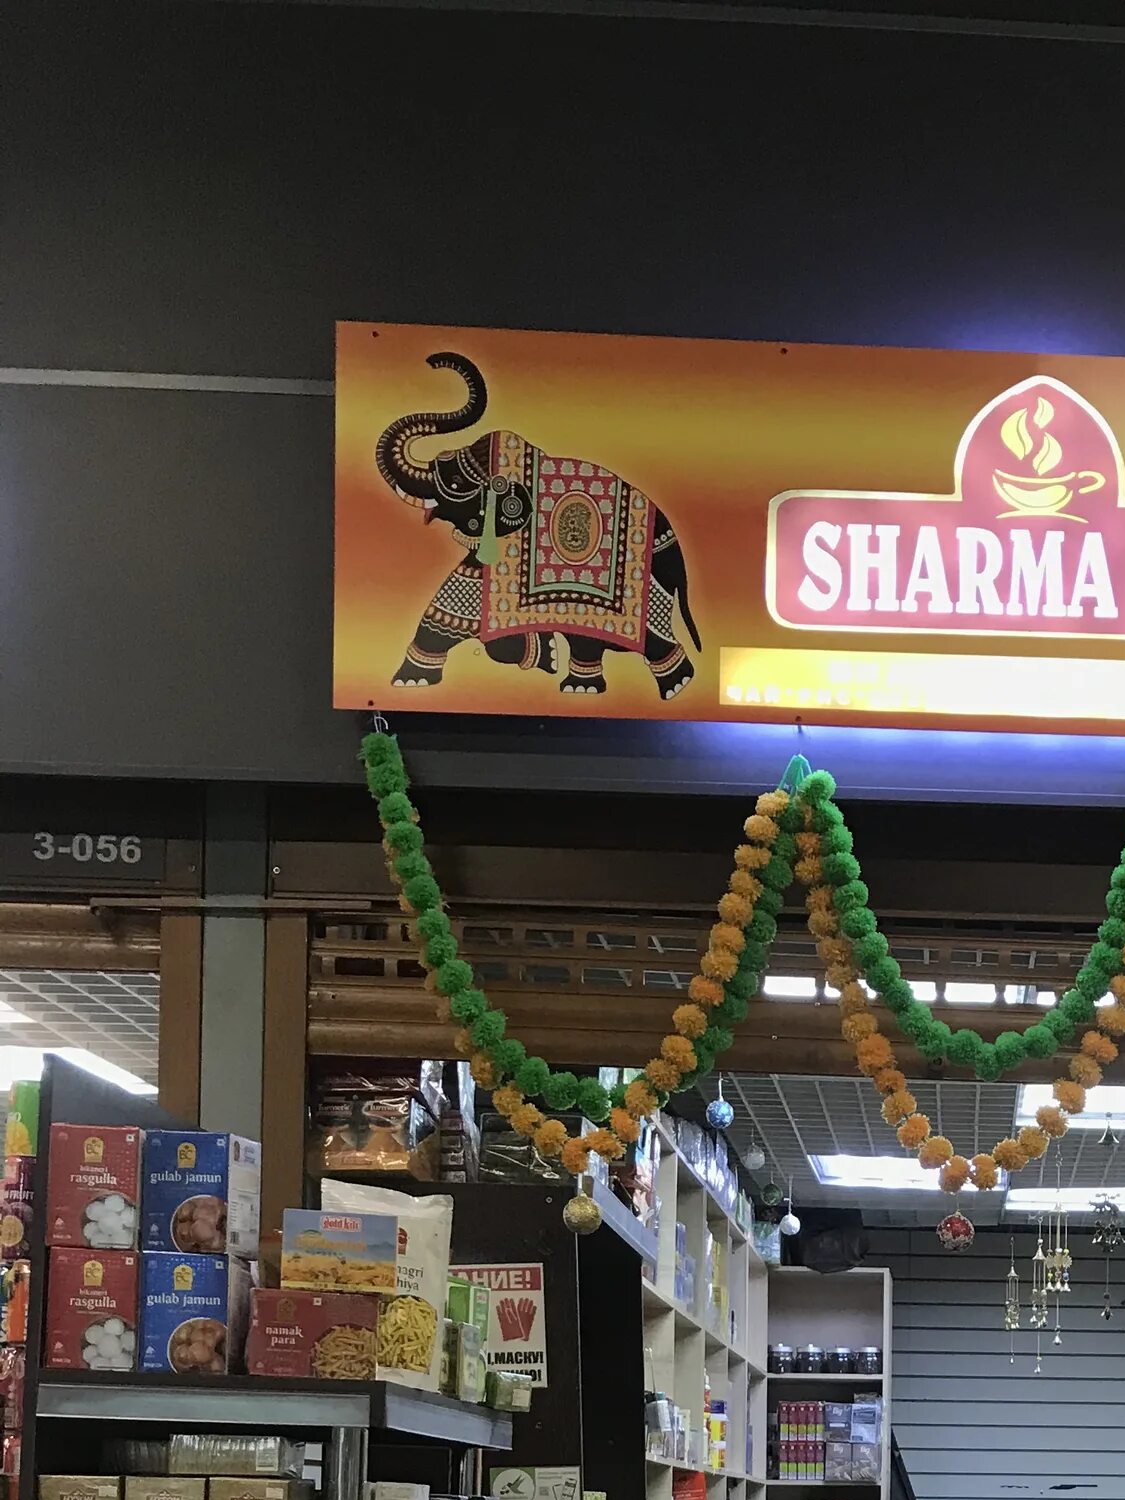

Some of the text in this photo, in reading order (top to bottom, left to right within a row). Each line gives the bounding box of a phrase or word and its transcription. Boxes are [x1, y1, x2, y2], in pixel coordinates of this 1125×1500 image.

[796, 520, 1119, 620] SHARMA
[33, 831, 143, 864] 3-056
[69, 1172, 117, 1187] rasgulla
[150, 1170, 222, 1185] gulab jamun
[69, 1295, 117, 1309] rasgulla
[146, 1292, 221, 1307] gulab jamun
[265, 1324, 303, 1338] namak
[271, 1335, 296, 1347] para
